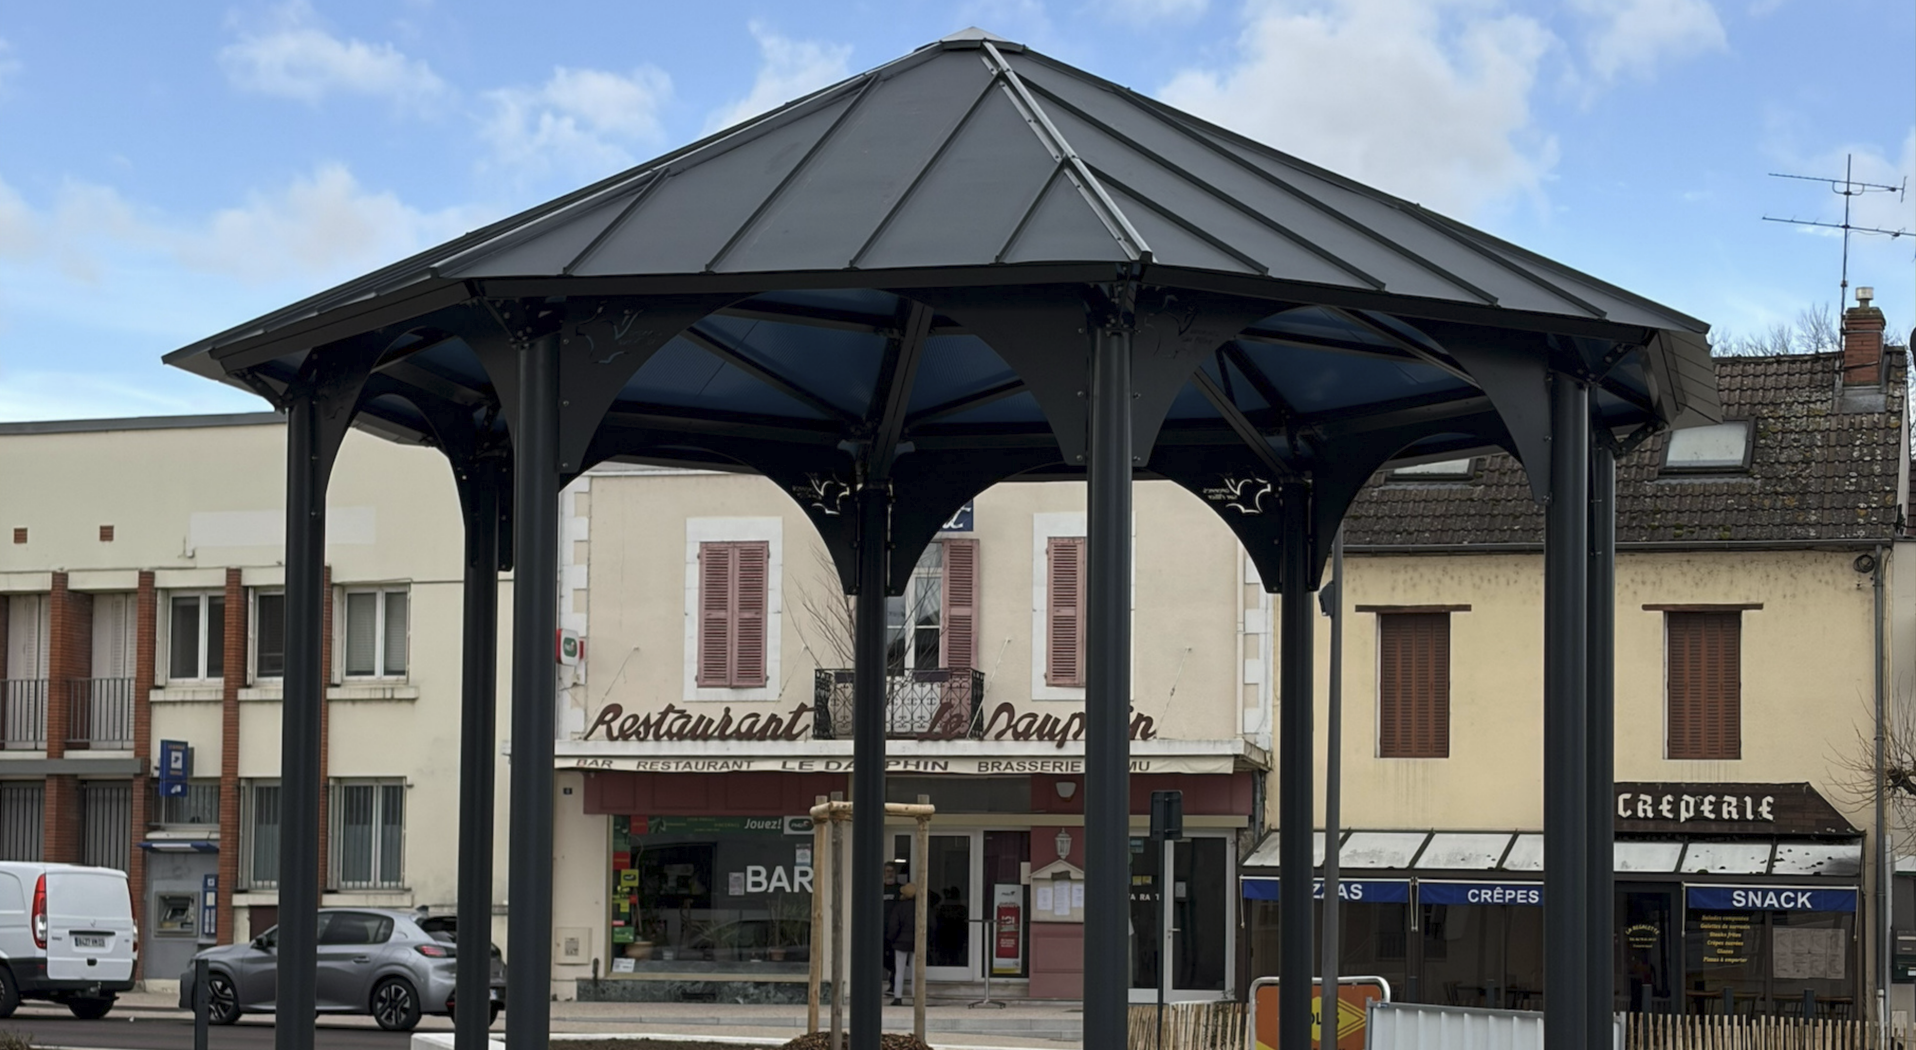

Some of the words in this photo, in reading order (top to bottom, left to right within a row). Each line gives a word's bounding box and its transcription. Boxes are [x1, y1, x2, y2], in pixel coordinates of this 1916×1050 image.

[583, 702, 816, 741] Restaurant
[981, 702, 1157, 749] Daupn
[576, 758, 613, 768] BAR
[636, 760, 756, 771] RESTAURANT
[780, 760, 816, 771] LE
[825, 760, 949, 771] DAPHIN
[977, 760, 1082, 773] BRASSERIE
[744, 818, 783, 830] Jouez!
[746, 865, 814, 893] BAR
[1467, 886, 1540, 904] CRÊPES
[1732, 890, 1813, 909] SNACK
